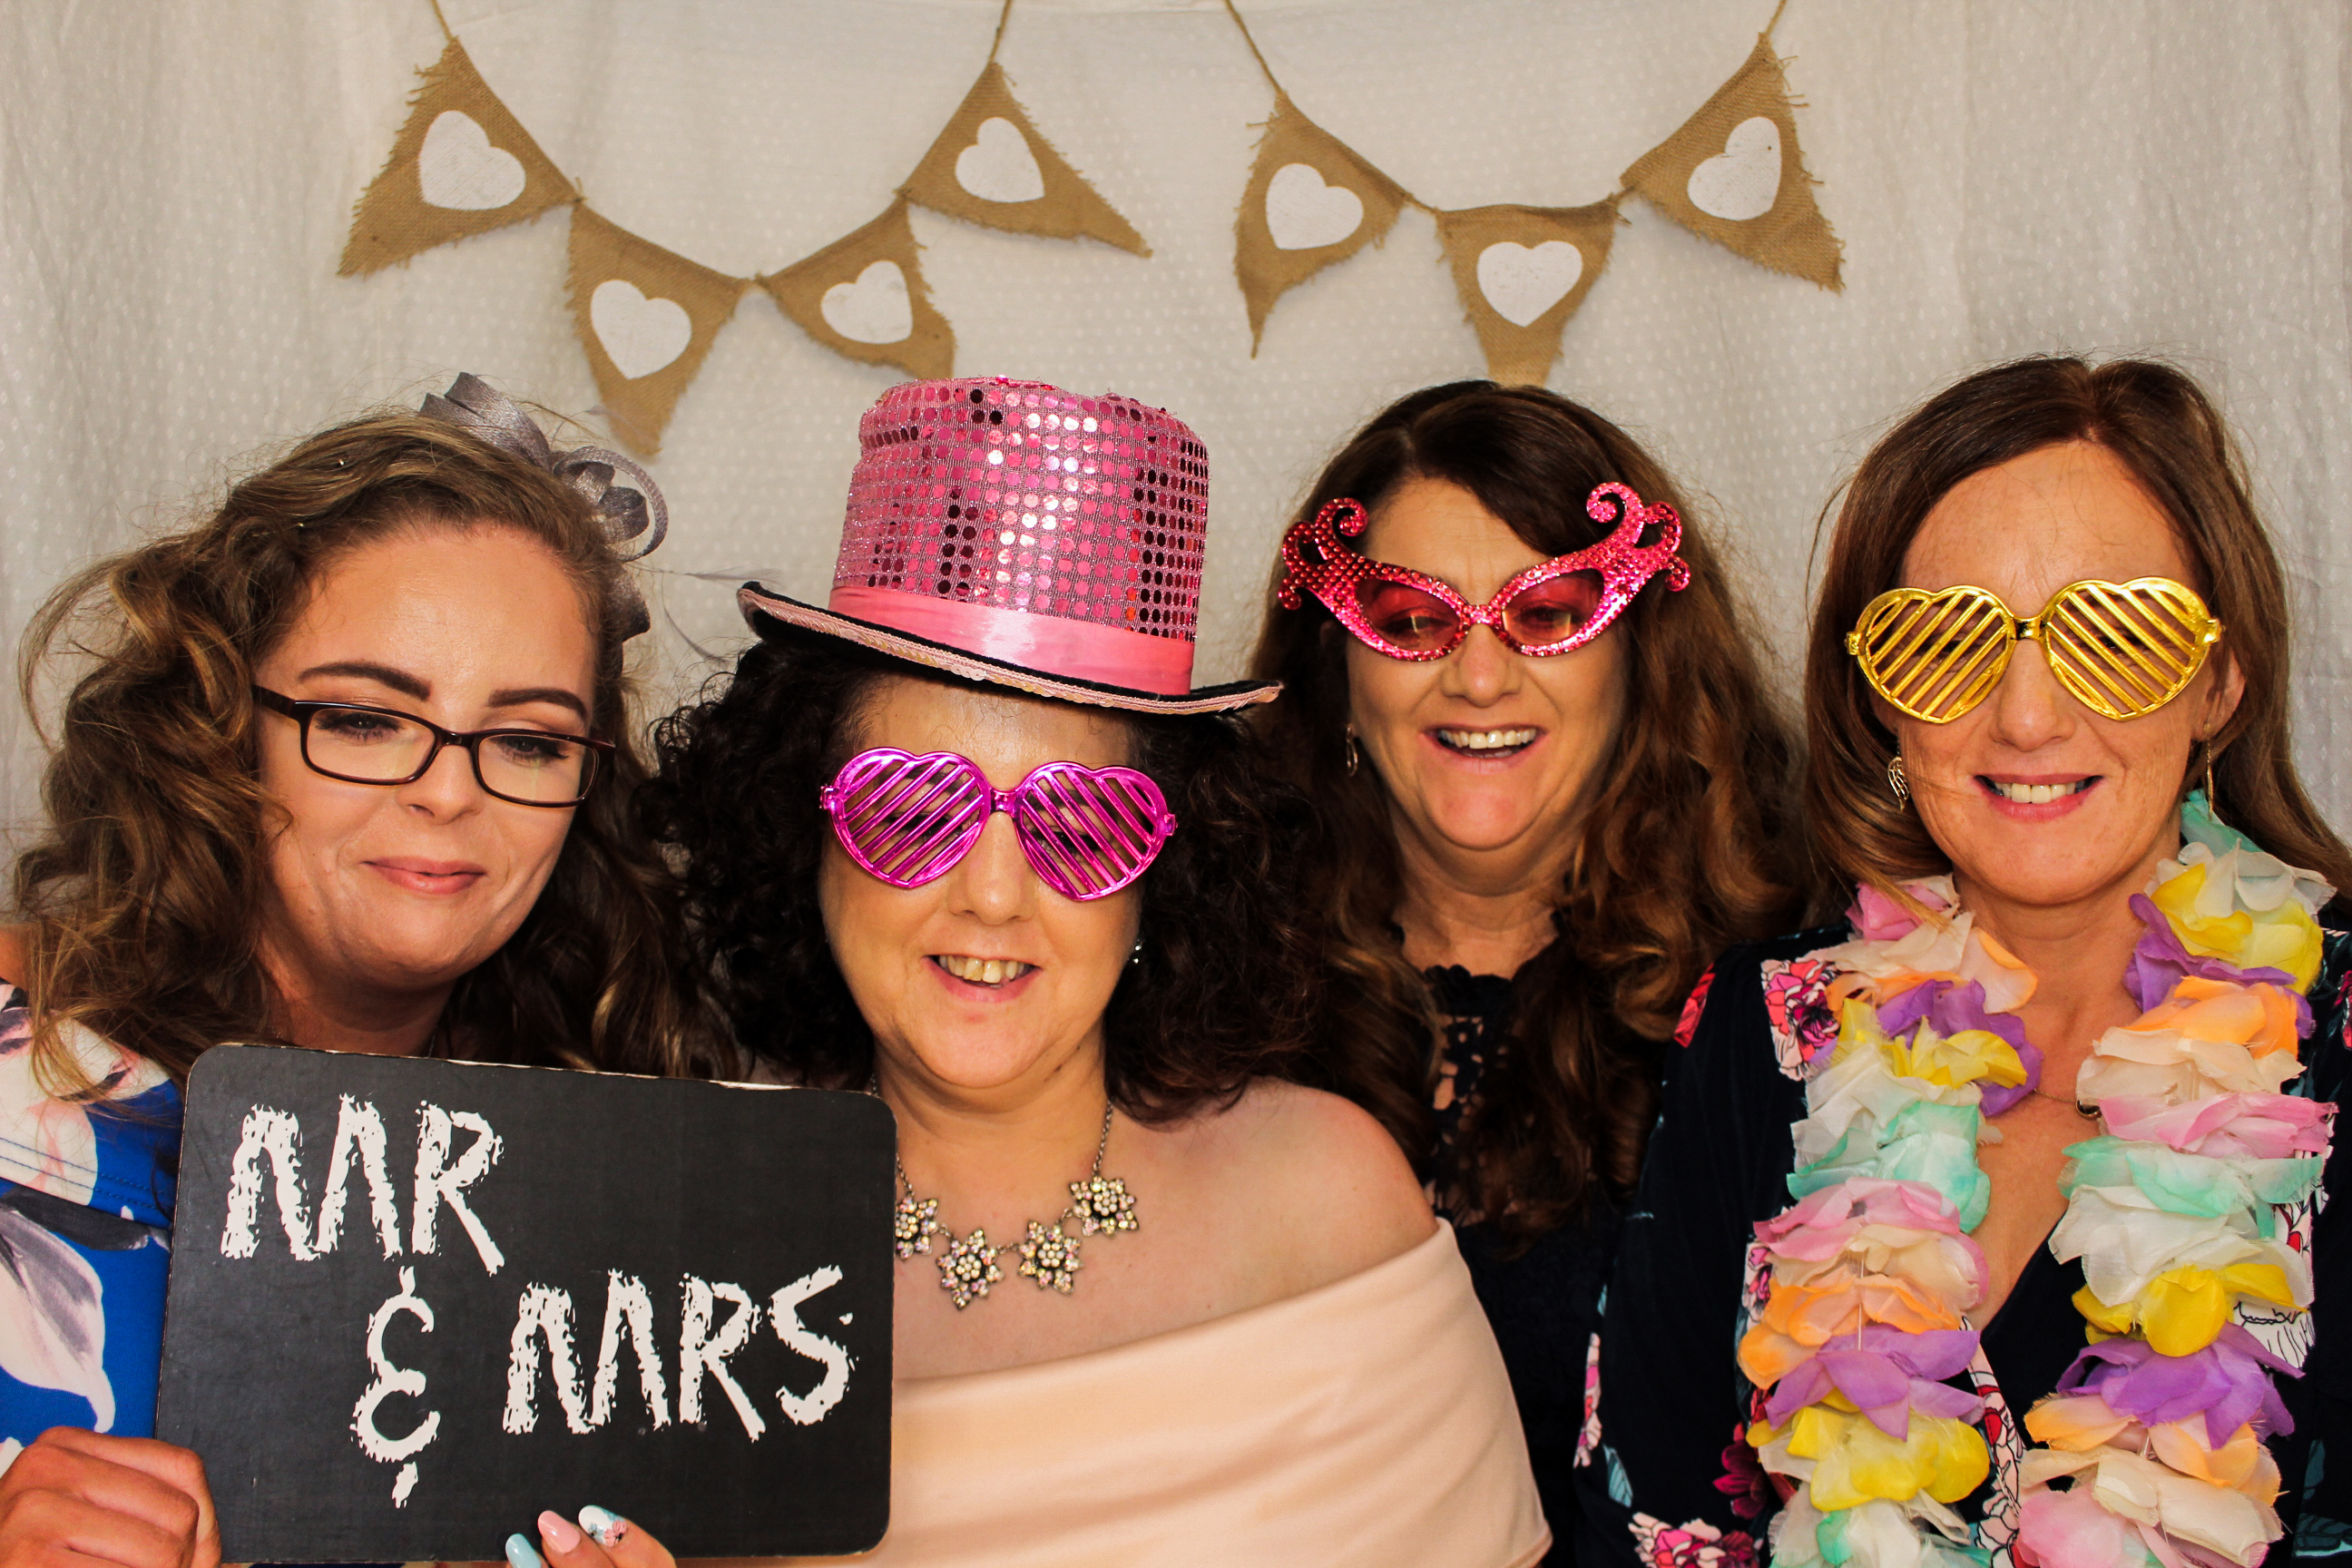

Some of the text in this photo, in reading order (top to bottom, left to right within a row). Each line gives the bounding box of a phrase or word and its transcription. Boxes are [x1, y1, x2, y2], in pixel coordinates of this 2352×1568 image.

[220, 1093, 505, 1277] MR
[349, 1265, 858, 1508] & MRS
